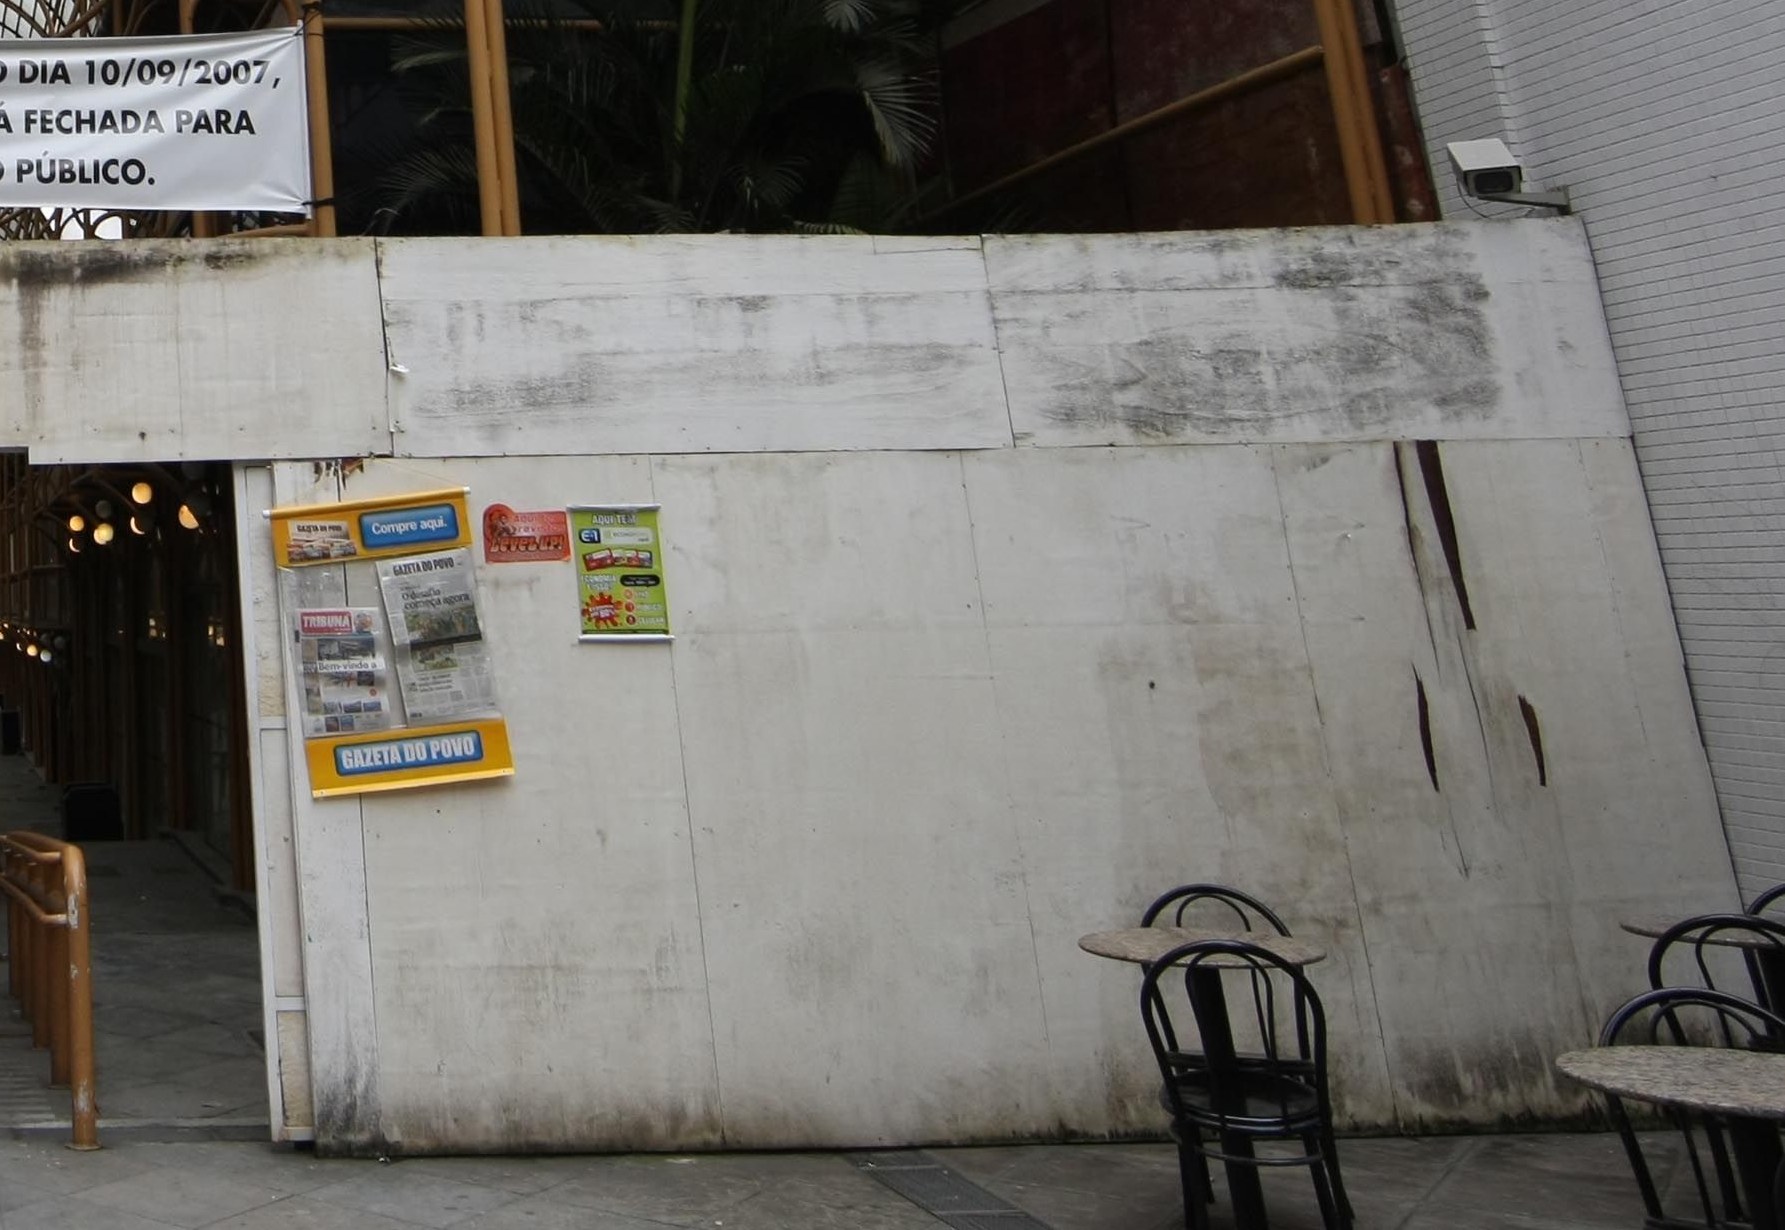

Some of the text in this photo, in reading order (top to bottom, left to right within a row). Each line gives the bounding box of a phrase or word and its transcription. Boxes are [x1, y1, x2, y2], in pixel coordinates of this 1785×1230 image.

[19, 59, 71, 85] DIA
[85, 58, 282, 89] 10/09/2007,
[24, 109, 165, 134] FECHADA
[175, 109, 256, 135] PARA
[17, 151, 156, 186] PÚBLICO.
[297, 525, 319, 533] GAZETA
[372, 516, 447, 535] Compre aqui.
[393, 557, 454, 576] GAZETA DO POVO
[443, 593, 470, 606] agora
[302, 615, 351, 628] TRIBUNA
[341, 736, 475, 769] GAZETA DO POVO
